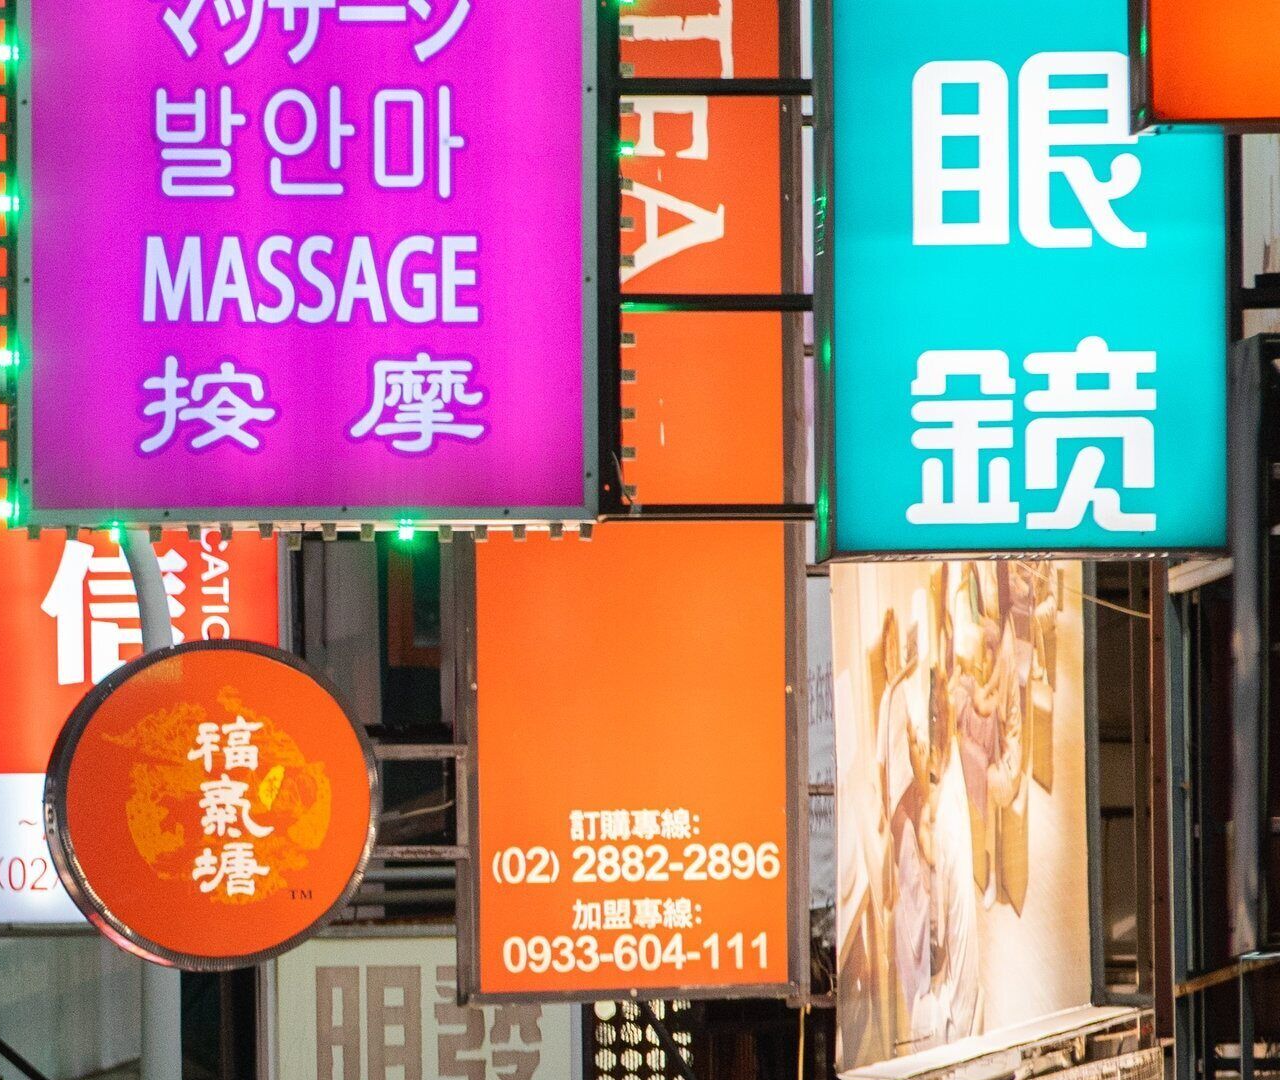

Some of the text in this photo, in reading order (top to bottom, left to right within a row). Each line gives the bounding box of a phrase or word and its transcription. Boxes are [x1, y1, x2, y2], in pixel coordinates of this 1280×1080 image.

[155, 84, 465, 198] 발안마
[620, 0, 734, 284] TEA
[142, 234, 480, 324] MASSAGE
[906, 51, 1157, 532] 眼鏡
[140, 352, 486, 454] 按摩
[41, 540, 188, 686] 信
[492, 841, 781, 884] (02) 2882-2896
[502, 931, 767, 973] 0933-604-111
